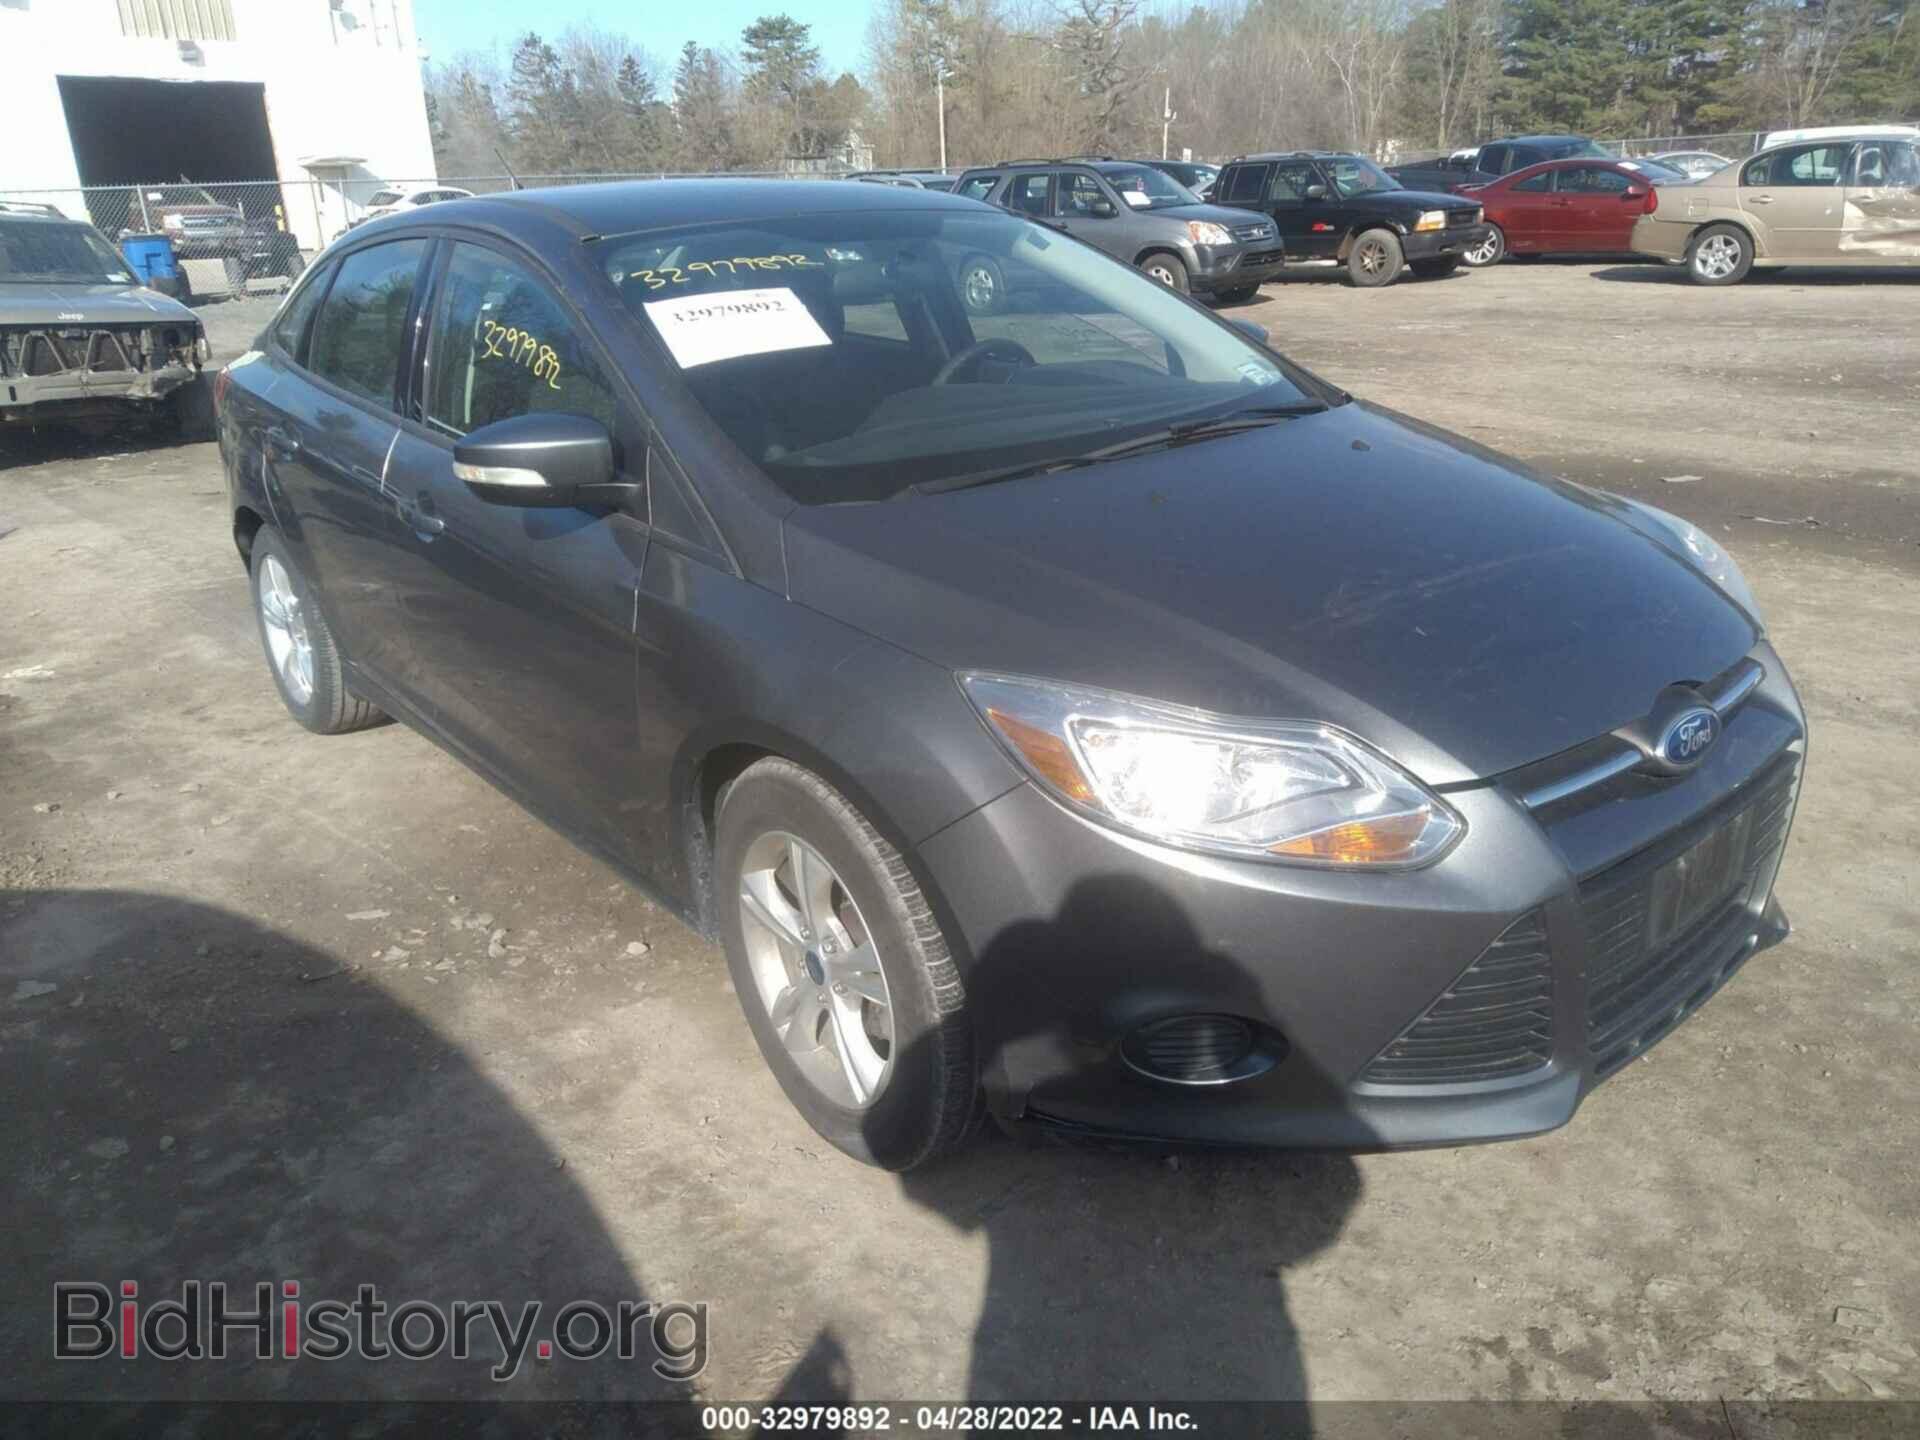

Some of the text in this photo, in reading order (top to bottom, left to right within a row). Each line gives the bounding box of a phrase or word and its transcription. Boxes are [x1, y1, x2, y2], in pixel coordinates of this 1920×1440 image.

[631, 254, 824, 289] 32979892
[481, 320, 561, 389] 32979892
[1680, 718, 1711, 757] Ford
